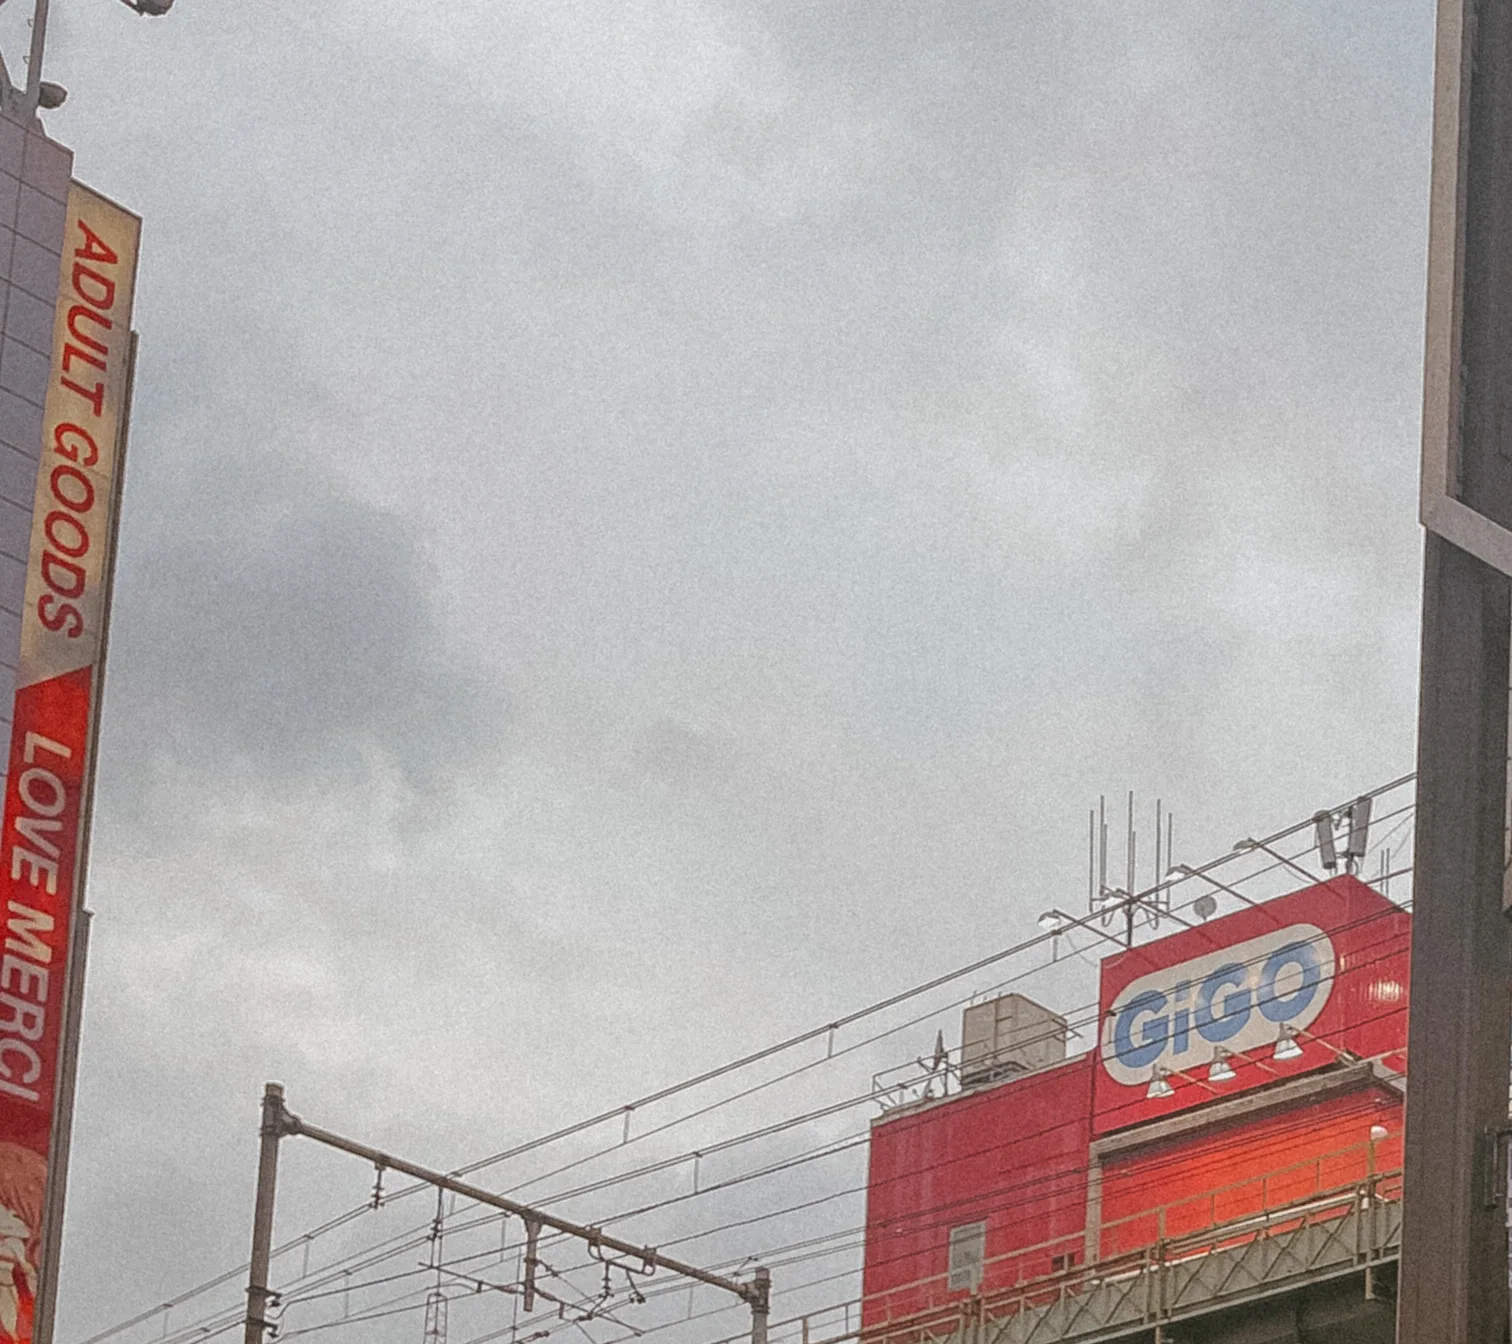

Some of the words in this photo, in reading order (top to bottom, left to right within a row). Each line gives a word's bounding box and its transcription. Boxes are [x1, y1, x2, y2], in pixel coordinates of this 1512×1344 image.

[60, 219, 118, 417] ADULT
[38, 421, 99, 639] GOODS
[11, 730, 71, 897] LOVE
[0, 905, 54, 1101] MERCI
